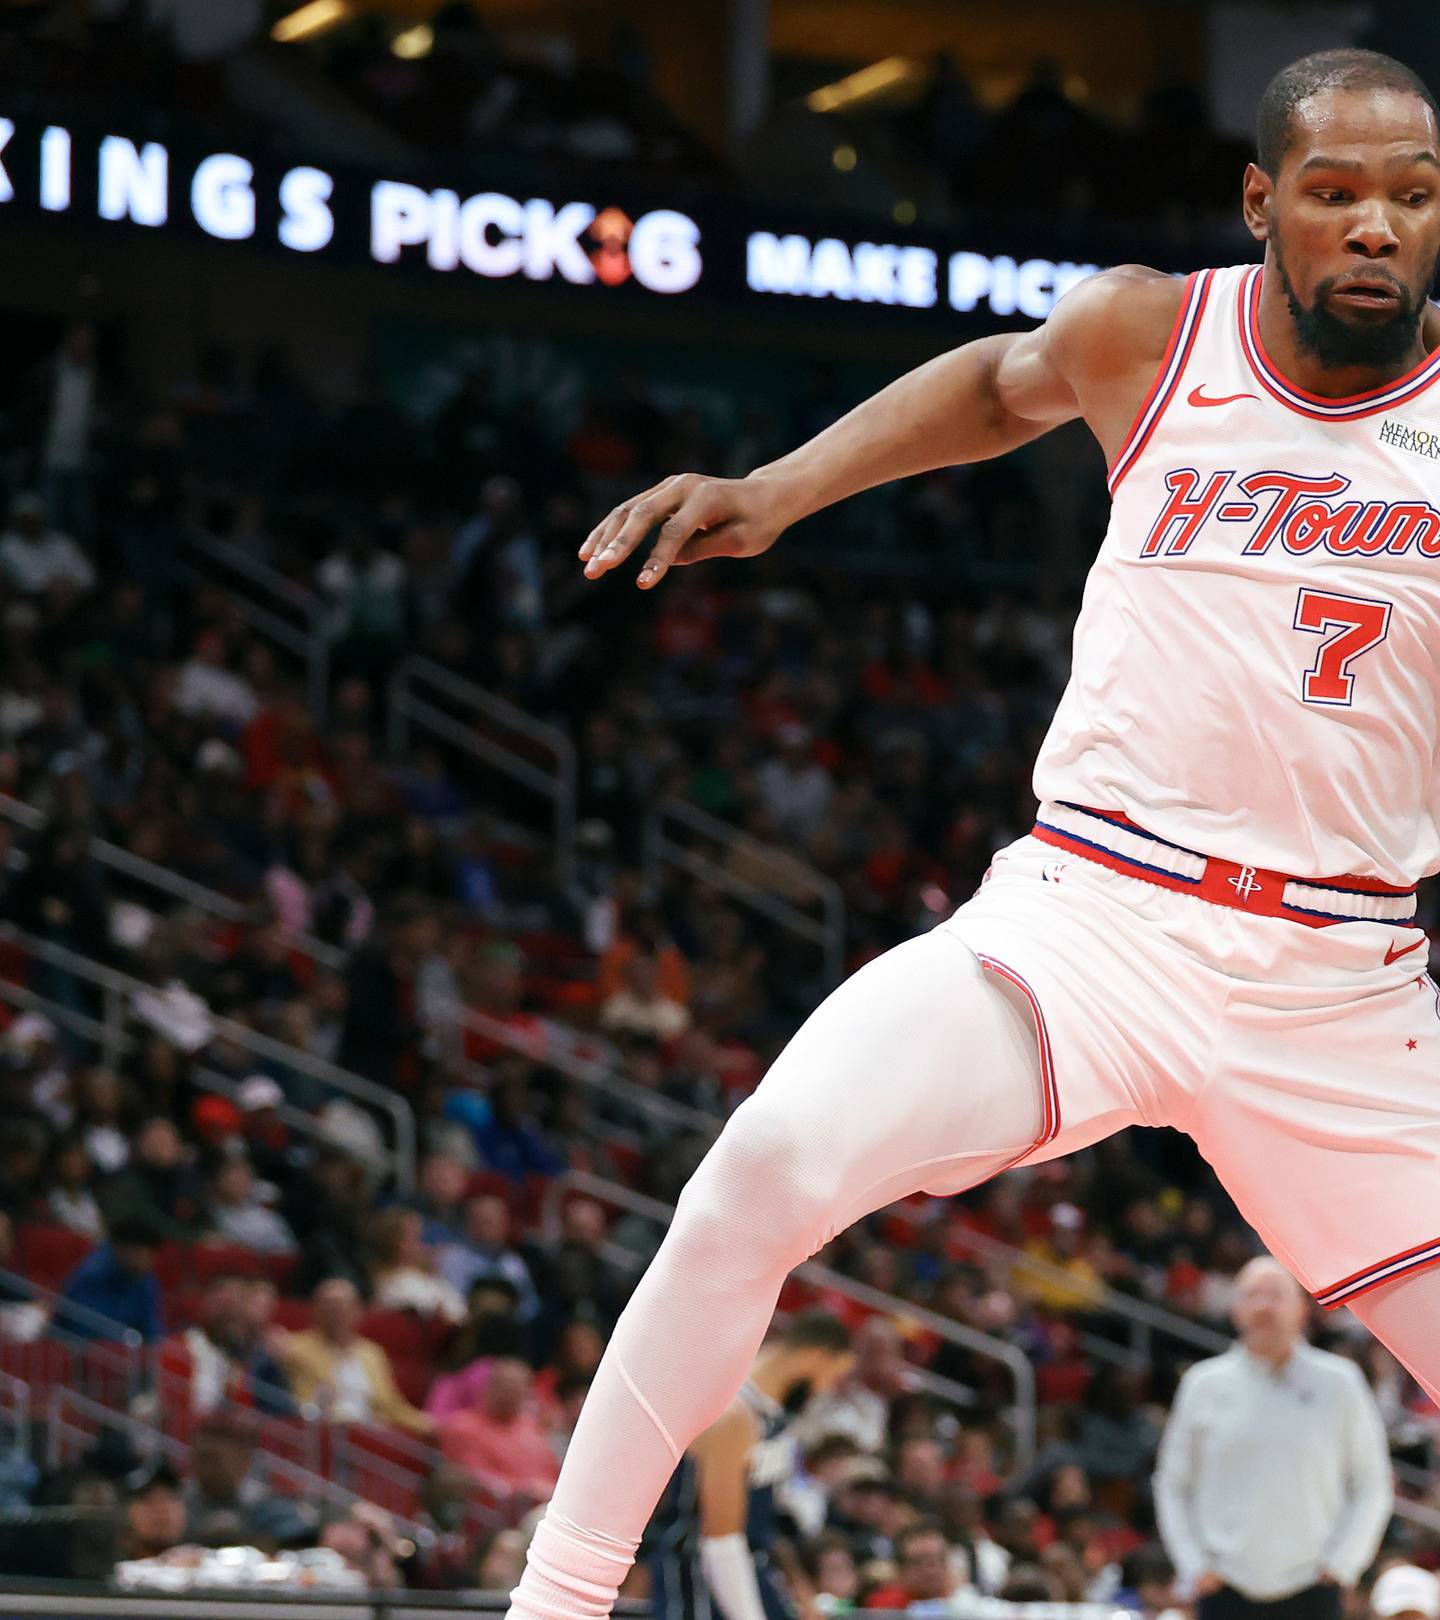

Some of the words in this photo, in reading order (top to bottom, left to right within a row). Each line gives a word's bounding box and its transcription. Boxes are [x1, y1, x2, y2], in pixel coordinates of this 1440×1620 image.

[0, 116, 335, 253] INGS
[747, 231, 938, 309] MAKE
[1293, 587, 1393, 706] 7
